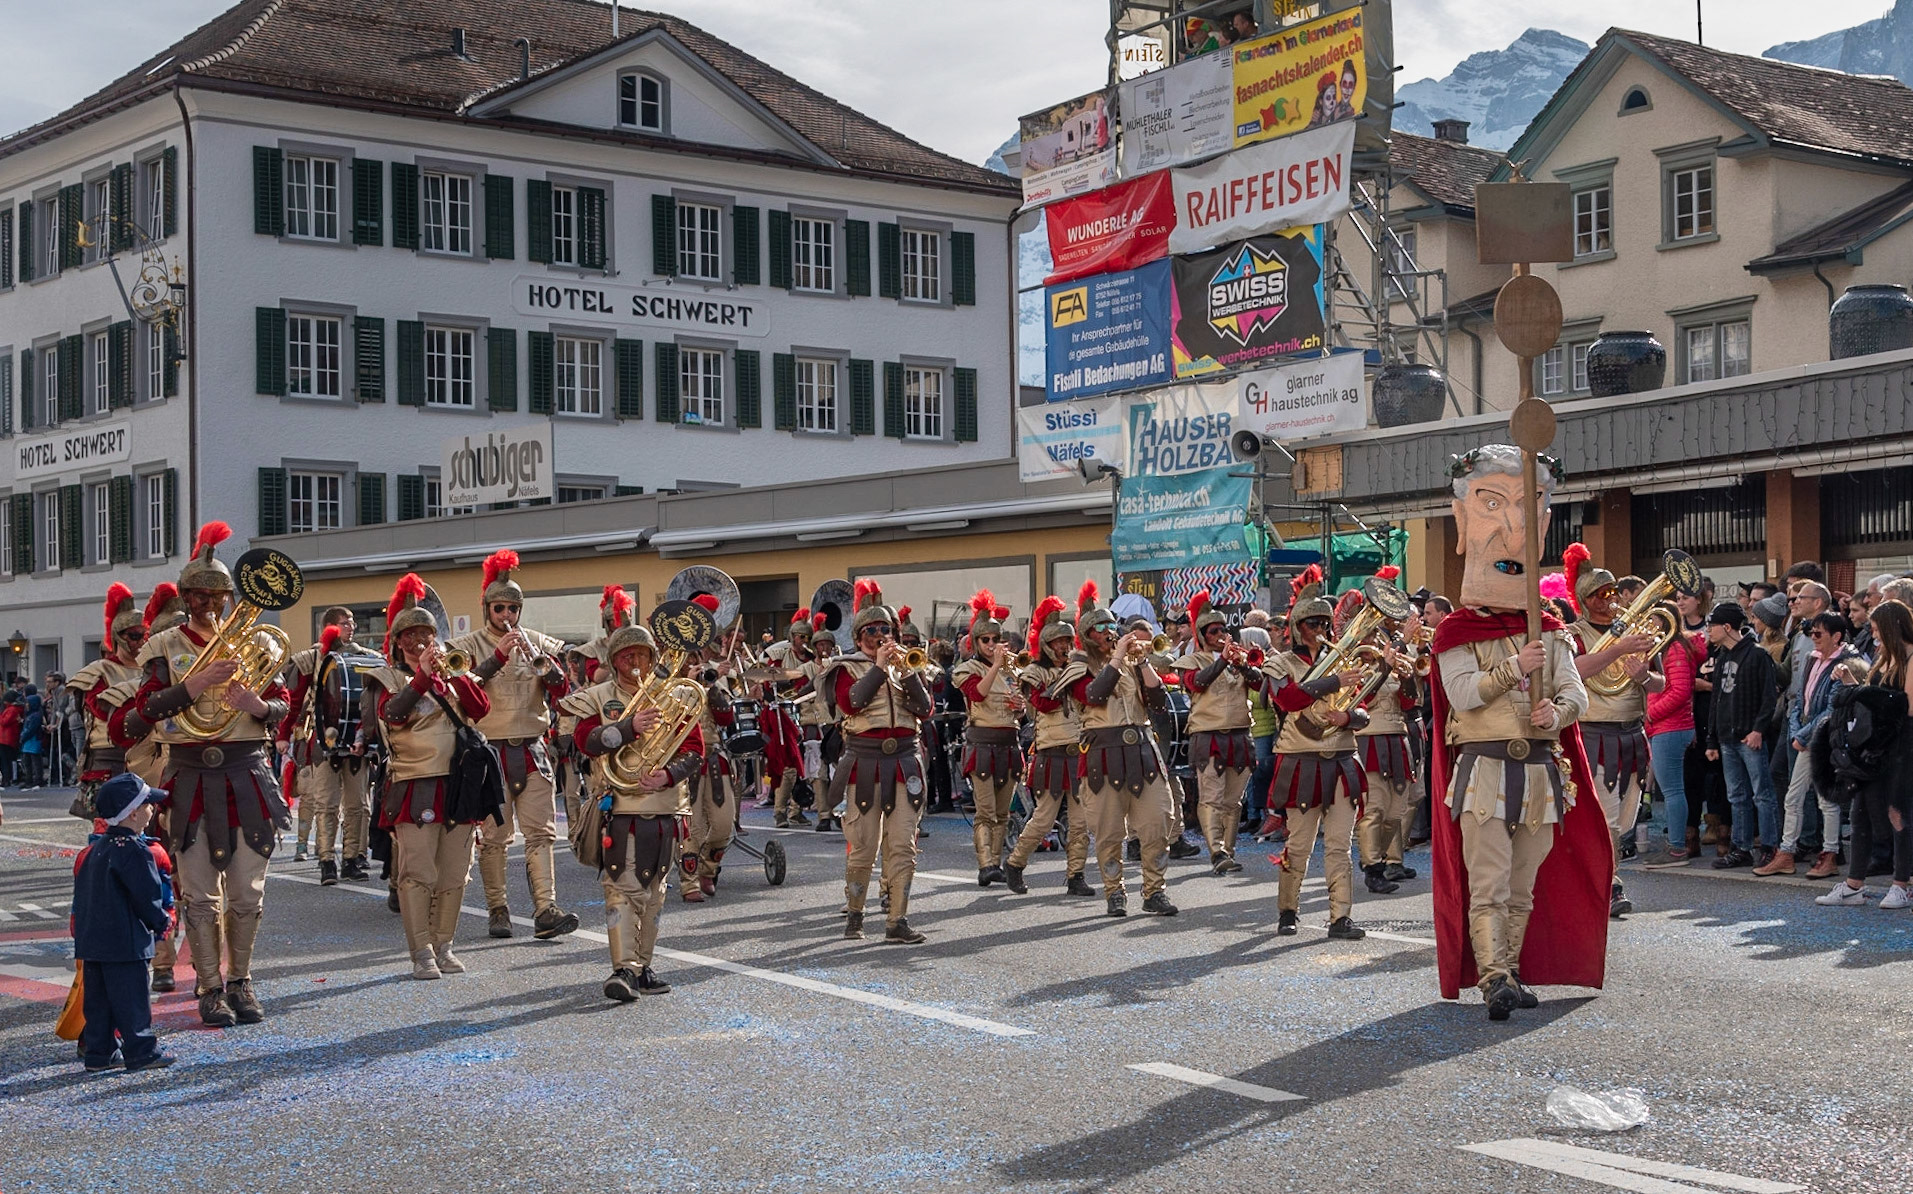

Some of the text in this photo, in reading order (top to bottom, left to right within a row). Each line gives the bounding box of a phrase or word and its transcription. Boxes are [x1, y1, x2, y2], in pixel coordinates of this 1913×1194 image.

[1283, 35, 1298, 51] im
[1299, 13, 1361, 45] Glarnerland
[1236, 33, 1363, 104] fasnachtskalender.ch
[1126, 108, 1173, 132] MÜHLETHALER
[1144, 122, 1171, 138] FISCHLI
[1187, 153, 1342, 230] RAIFFEISEN
[1067, 212, 1128, 243] WUNDERLE
[1129, 207, 1145, 226] AG
[1140, 226, 1167, 238] SOLAR
[1212, 272, 1284, 306] SWISS
[529, 284, 753, 327] HOTEL SCHWERT
[1054, 292, 1086, 323] FA
[1212, 294, 1284, 317] WERBETECHNIK
[1071, 318, 1143, 343] Ihr Ansprechpartner für
[1076, 346, 1105, 361] gesamte
[1105, 335, 1150, 354] Gebäudehülle
[1053, 353, 1166, 393] Fischli Bedachungen AG
[1286, 373, 1325, 394] glarner
[1271, 388, 1359, 412] haustechnik ag
[1045, 408, 1097, 431] Stüssi
[1140, 412, 1232, 446] HAUSER
[1265, 413, 1336, 433] glarner-haustechnik.ch
[20, 429, 125, 470] HOTEL SCHWERT
[1046, 441, 1095, 462] Näfels
[1140, 441, 1236, 472] HOLZBA
[449, 433, 543, 498] schubiger
[449, 486, 540, 504] Kaufhaus Näfels
[1120, 485, 1210, 515] casa-technica.ch
[1173, 513, 1230, 530] Gebäudetechnik
[1232, 509, 1243, 523] AG
[269, 552, 301, 600] GUGGÄMUSIG
[1127, 578, 1155, 597] STEIN
